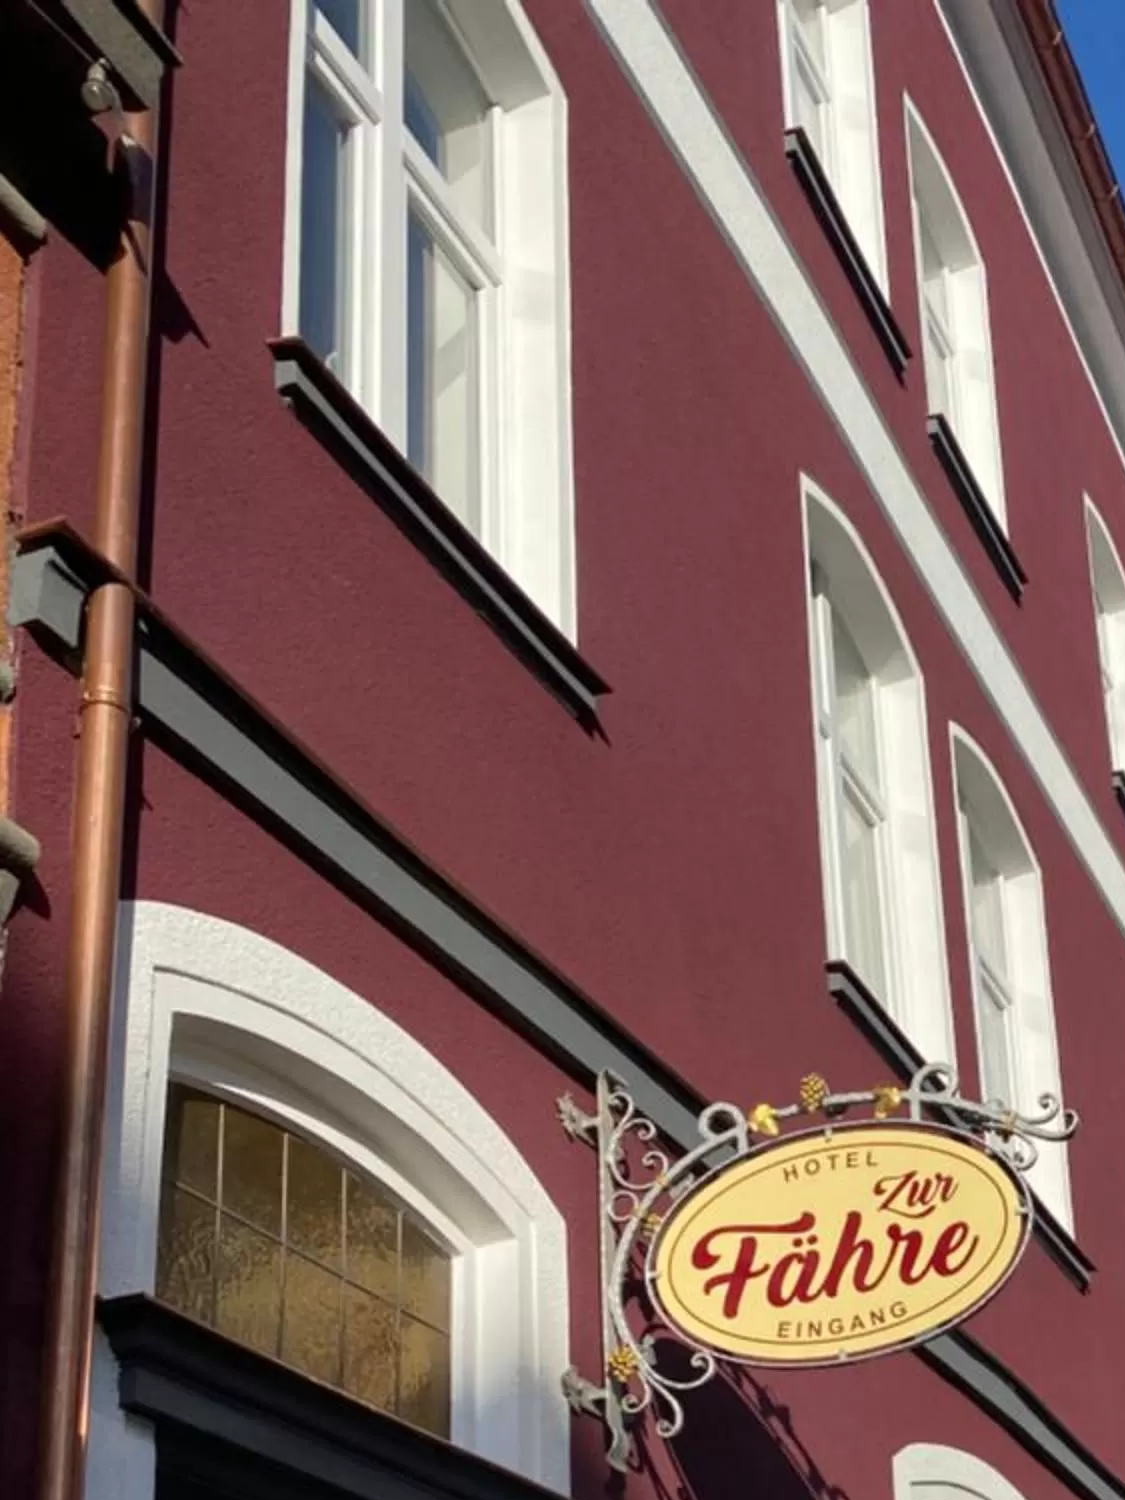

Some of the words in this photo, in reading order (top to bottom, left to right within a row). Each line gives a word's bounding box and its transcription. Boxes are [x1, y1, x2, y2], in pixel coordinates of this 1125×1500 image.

[782, 1151, 879, 1183] HOTEL
[873, 1170, 959, 1218] Zur
[691, 1211, 979, 1319] Fähre
[778, 1301, 909, 1339] EINGANG
